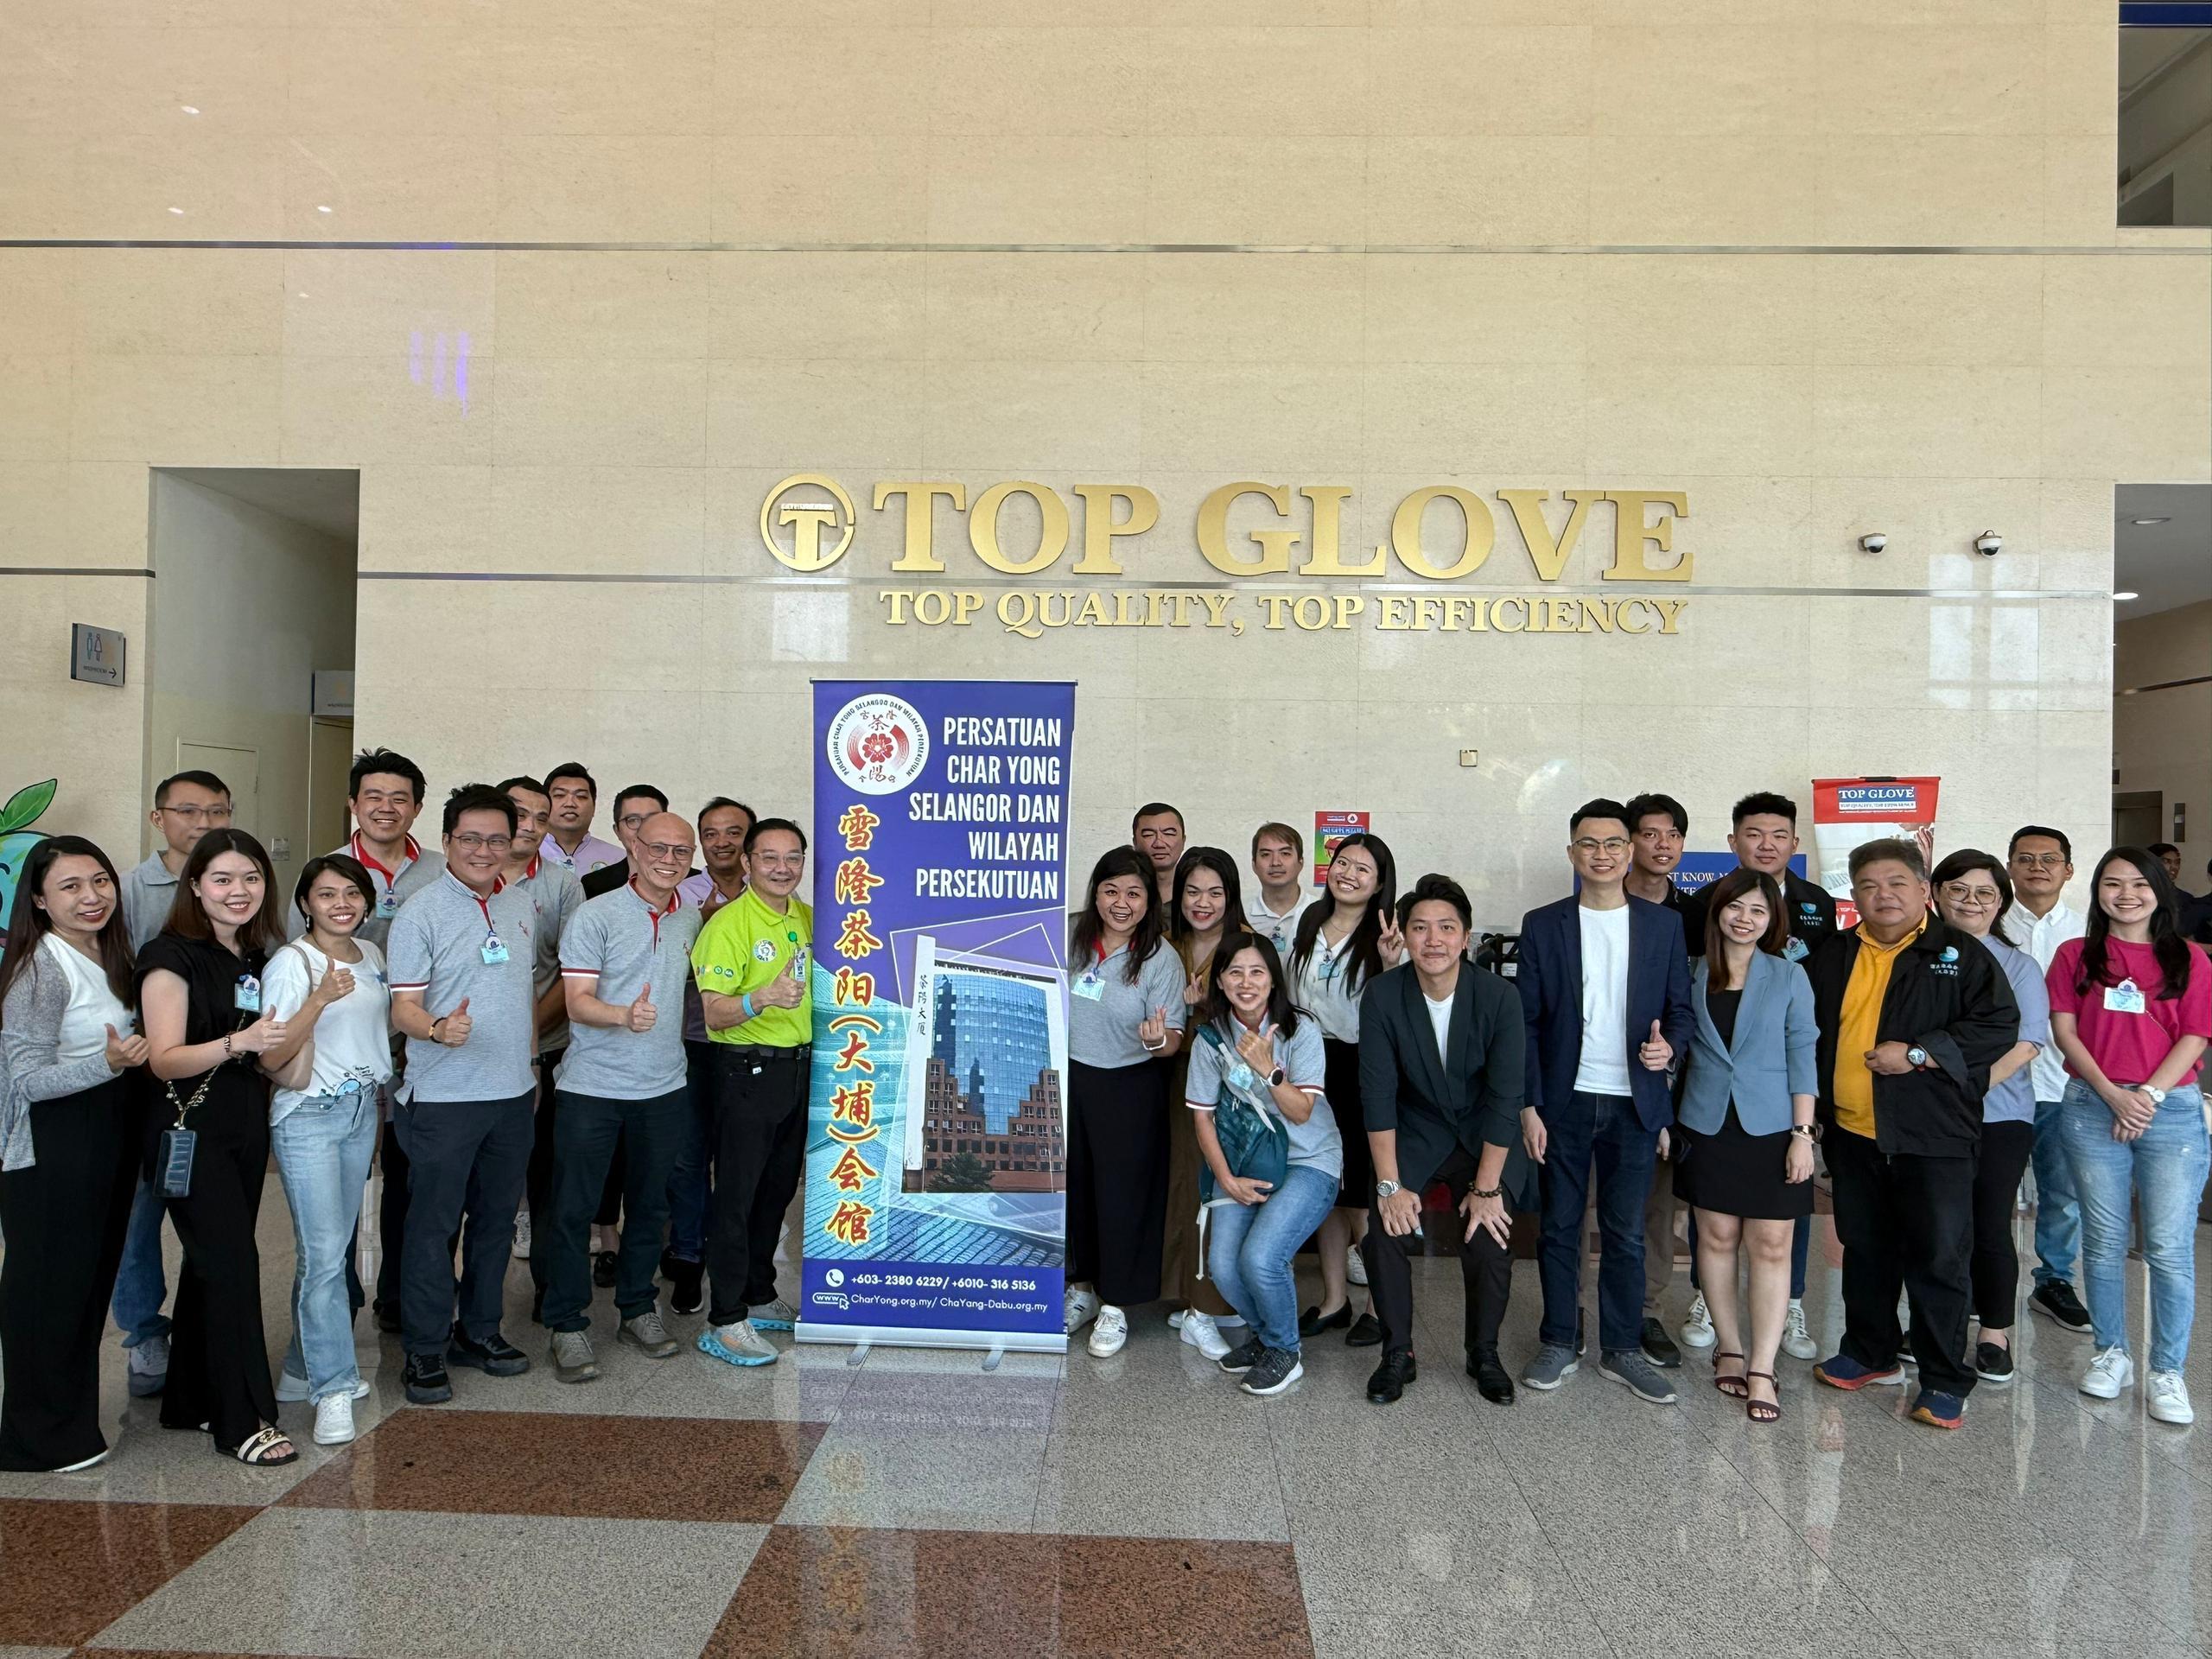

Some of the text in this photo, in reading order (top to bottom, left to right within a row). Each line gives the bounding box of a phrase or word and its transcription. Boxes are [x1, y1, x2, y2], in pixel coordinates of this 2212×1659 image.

[873, 480, 1694, 582] TOP GLOVE
[880, 589, 1690, 639] TOP QUALITY, TOP EFFICIENCY
[944, 717, 1061, 748] PERSATUAN
[947, 756, 1060, 786] CHAR YONG
[908, 792, 1060, 823] SELANGOR DAN
[1839, 788, 1915, 799] TOP GLOVE
[968, 832, 1059, 862] WILAYAH
[916, 869, 1058, 900] PERSEKUTUAN
[851, 1274, 1036, 1291] +603- 2380 6229/ +6010- 316 5136
[851, 1294, 1048, 1313] CharYong.org.my/ ChaYang-Dabu.org.my
